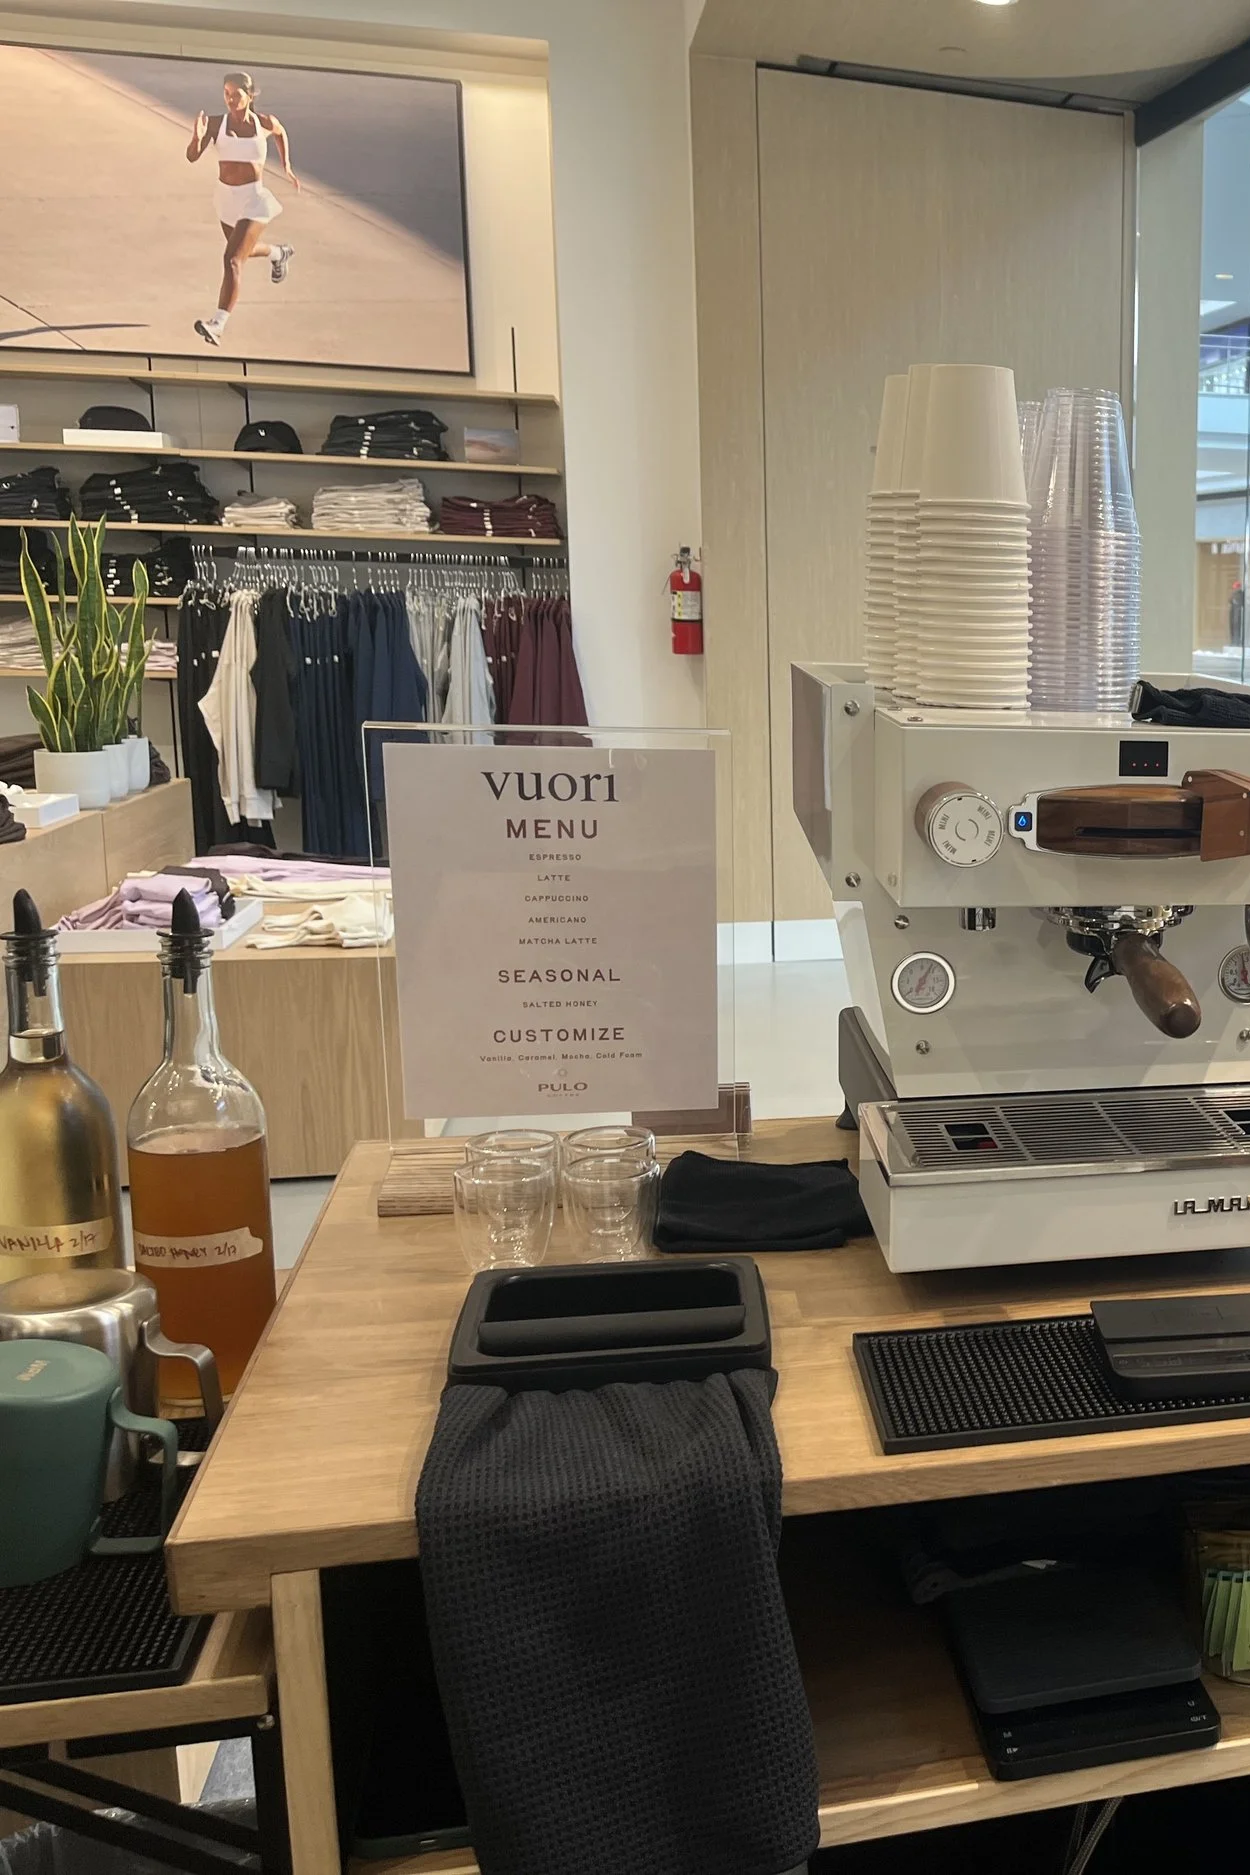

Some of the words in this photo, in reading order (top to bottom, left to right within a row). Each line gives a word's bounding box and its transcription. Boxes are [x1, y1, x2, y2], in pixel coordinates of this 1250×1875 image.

[480, 771, 620, 803] vuori
[506, 818, 598, 839] MENU
[528, 853, 582, 861] ESPRESSO
[537, 874, 571, 882] LATTE
[528, 916, 587, 924] AMERICANO
[518, 937, 561, 945] MATCHA
[564, 937, 598, 945] LATTE
[498, 968, 621, 983] SEASONAL
[565, 1000, 598, 1008] HONEY
[493, 1027, 625, 1043] CUSTOMIZE
[537, 1082, 589, 1092] PULO
